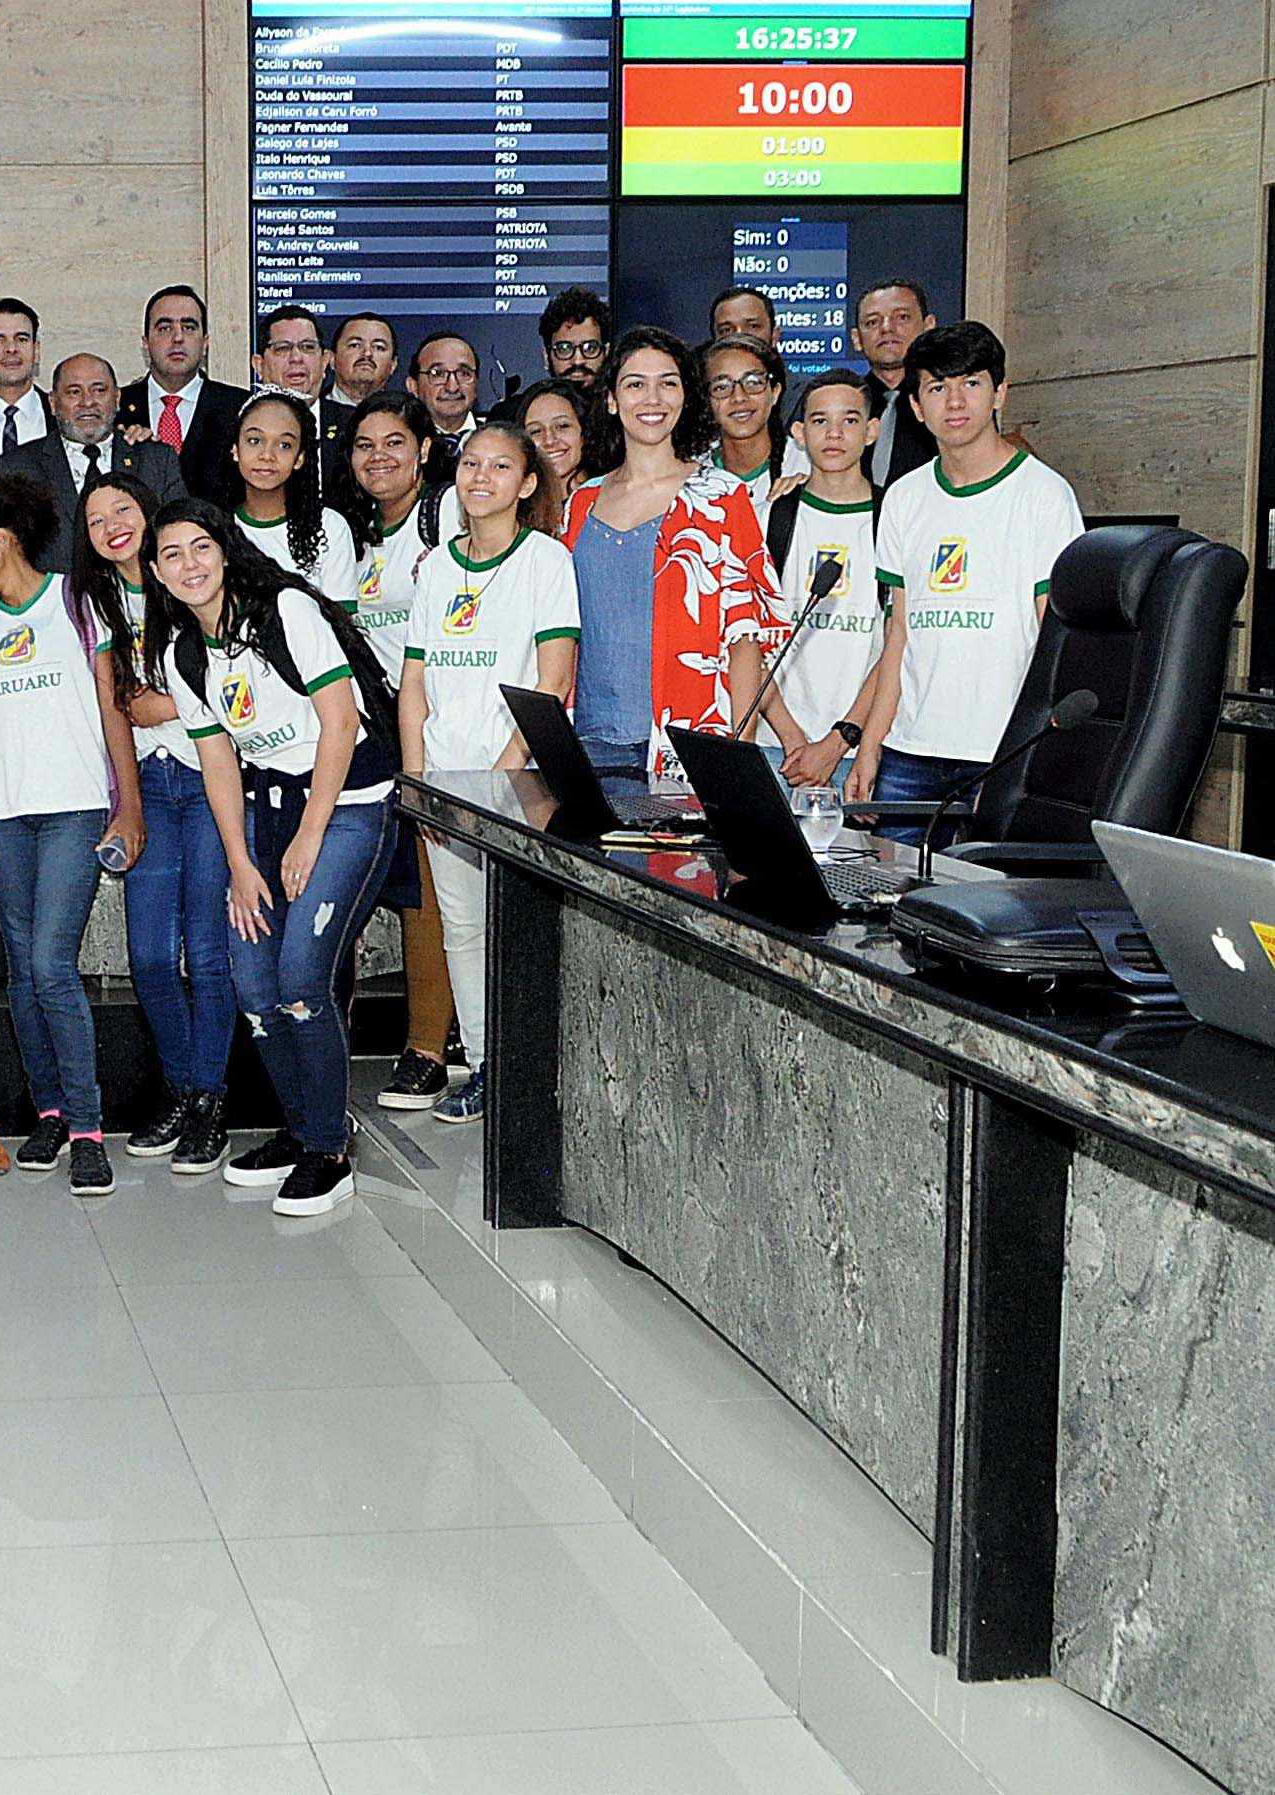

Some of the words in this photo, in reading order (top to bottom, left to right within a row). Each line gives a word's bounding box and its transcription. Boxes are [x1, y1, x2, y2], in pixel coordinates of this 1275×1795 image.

[735, 28, 857, 50] 16:25:37
[496, 42, 517, 54] PDT
[292, 58, 324, 70] Pedro
[496, 58, 521, 70] MDB
[255, 74, 289, 86] Daniel
[316, 74, 356, 86] Finizola
[496, 74, 510, 85] PT
[255, 90, 284, 102] Duda
[286, 90, 300, 101] do
[302, 90, 353, 102] Vassoural
[495, 89, 524, 101] PRTB
[738, 82, 853, 114] 10:00
[255, 106, 303, 119] Edjailson
[305, 106, 319, 117] da
[322, 105, 347, 117] Caru
[349, 105, 378, 117] Forró
[495, 105, 524, 117] PRTB
[255, 122, 292, 135] Fagner
[294, 122, 349, 133] Fernandes
[495, 121, 532, 132] Avante
[255, 138, 293, 151] Galego
[295, 138, 309, 149] de
[311, 138, 340, 151] Lajes
[495, 136, 518, 148] PSD
[761, 137, 825, 156] 01:00
[283, 153, 331, 166] Henrique
[495, 152, 518, 164] PSD
[256, 169, 305, 180] Leonardo
[307, 168, 346, 180] Chaves
[495, 168, 517, 179] PDT
[763, 169, 822, 188] 03:00
[495, 183, 525, 195] PSDB
[257, 208, 298, 220] Marcelo
[300, 208, 337, 220] Gomes
[496, 207, 518, 219] PSB
[257, 224, 296, 237] Moysés
[298, 225, 335, 236] Santos
[496, 222, 548, 234] PATRIOTA
[733, 228, 772, 246] Sim:
[777, 229, 789, 246] 0
[257, 240, 275, 251] Pb.
[276, 240, 314, 253] Andrey
[316, 240, 360, 251] Gouveia
[496, 238, 548, 249] PATRIOTA
[257, 256, 296, 267] Pierson
[298, 256, 325, 267] Leite
[495, 254, 518, 266] PSD
[733, 255, 772, 273] Não:
[777, 256, 789, 273] 0
[257, 271, 302, 282] Ranilson
[304, 270, 362, 282] Enfermeiro
[495, 269, 517, 281] PDT
[257, 286, 293, 298] Tafarel
[495, 285, 548, 297] PATRIOTA
[835, 282, 848, 299] 0
[495, 300, 510, 312] PV
[823, 310, 844, 326] 18
[776, 337, 826, 354] votos:
[830, 336, 843, 353] 0
[908, 610, 995, 629] CARUARU
